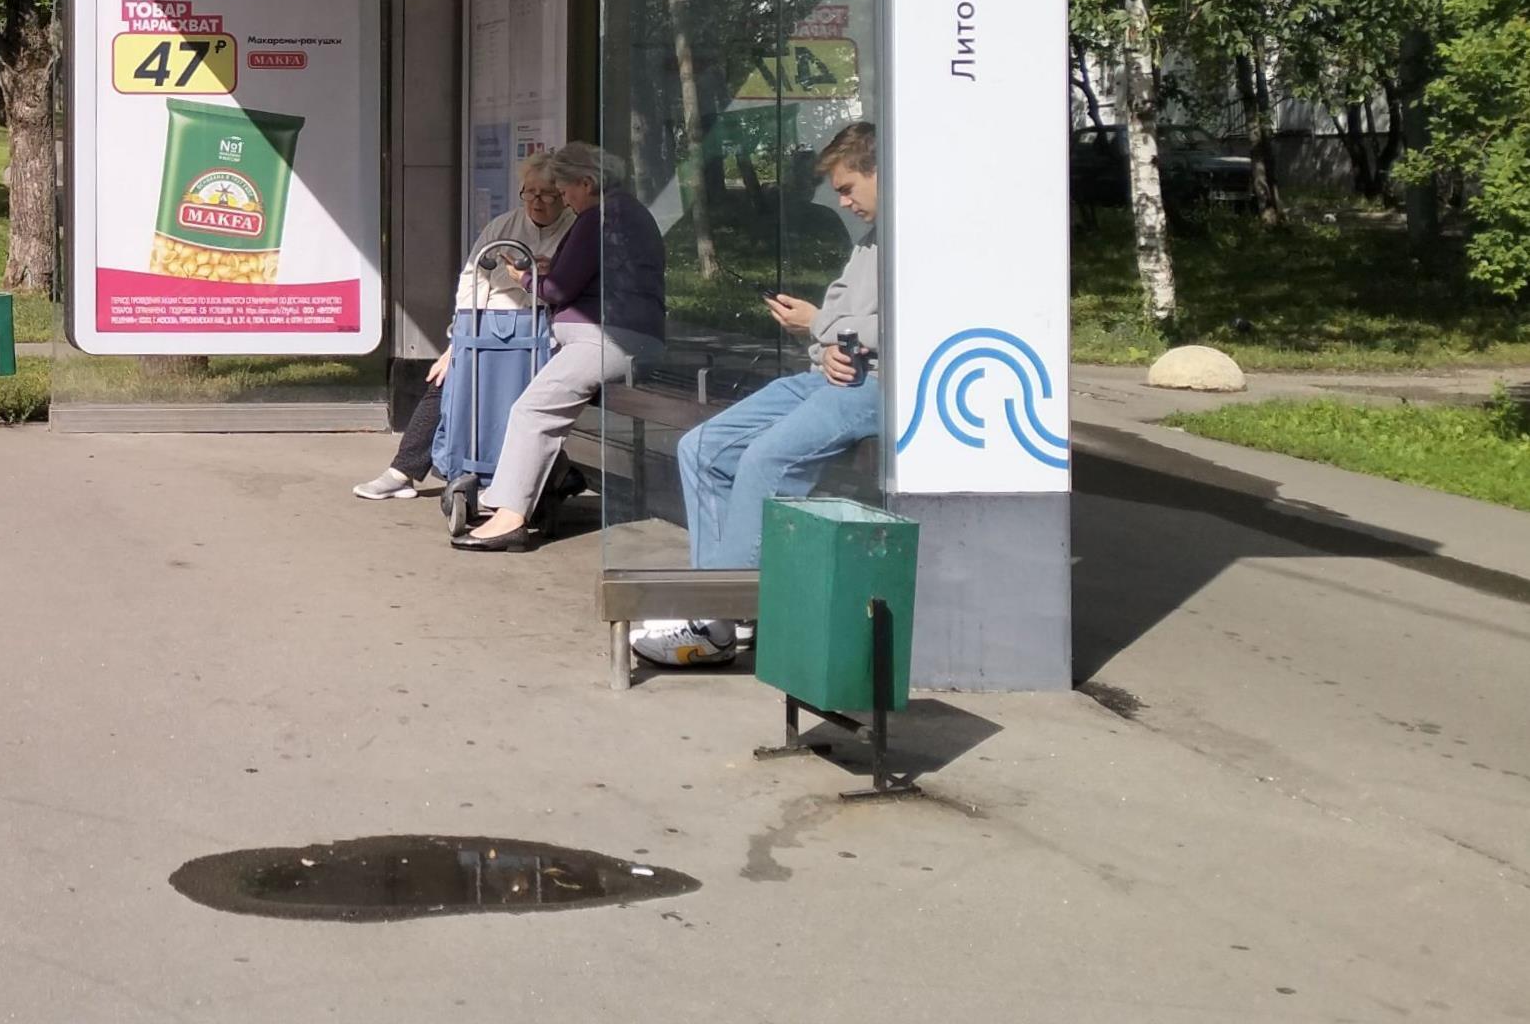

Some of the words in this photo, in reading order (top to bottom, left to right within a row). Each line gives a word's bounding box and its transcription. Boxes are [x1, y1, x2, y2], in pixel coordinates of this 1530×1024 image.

[125, 1, 187, 18] ТОВАР
[133, 19, 219, 32] НАРАСХВАТ
[253, 55, 302, 66] MAKFA
[187, 208, 254, 231] MAKFA
